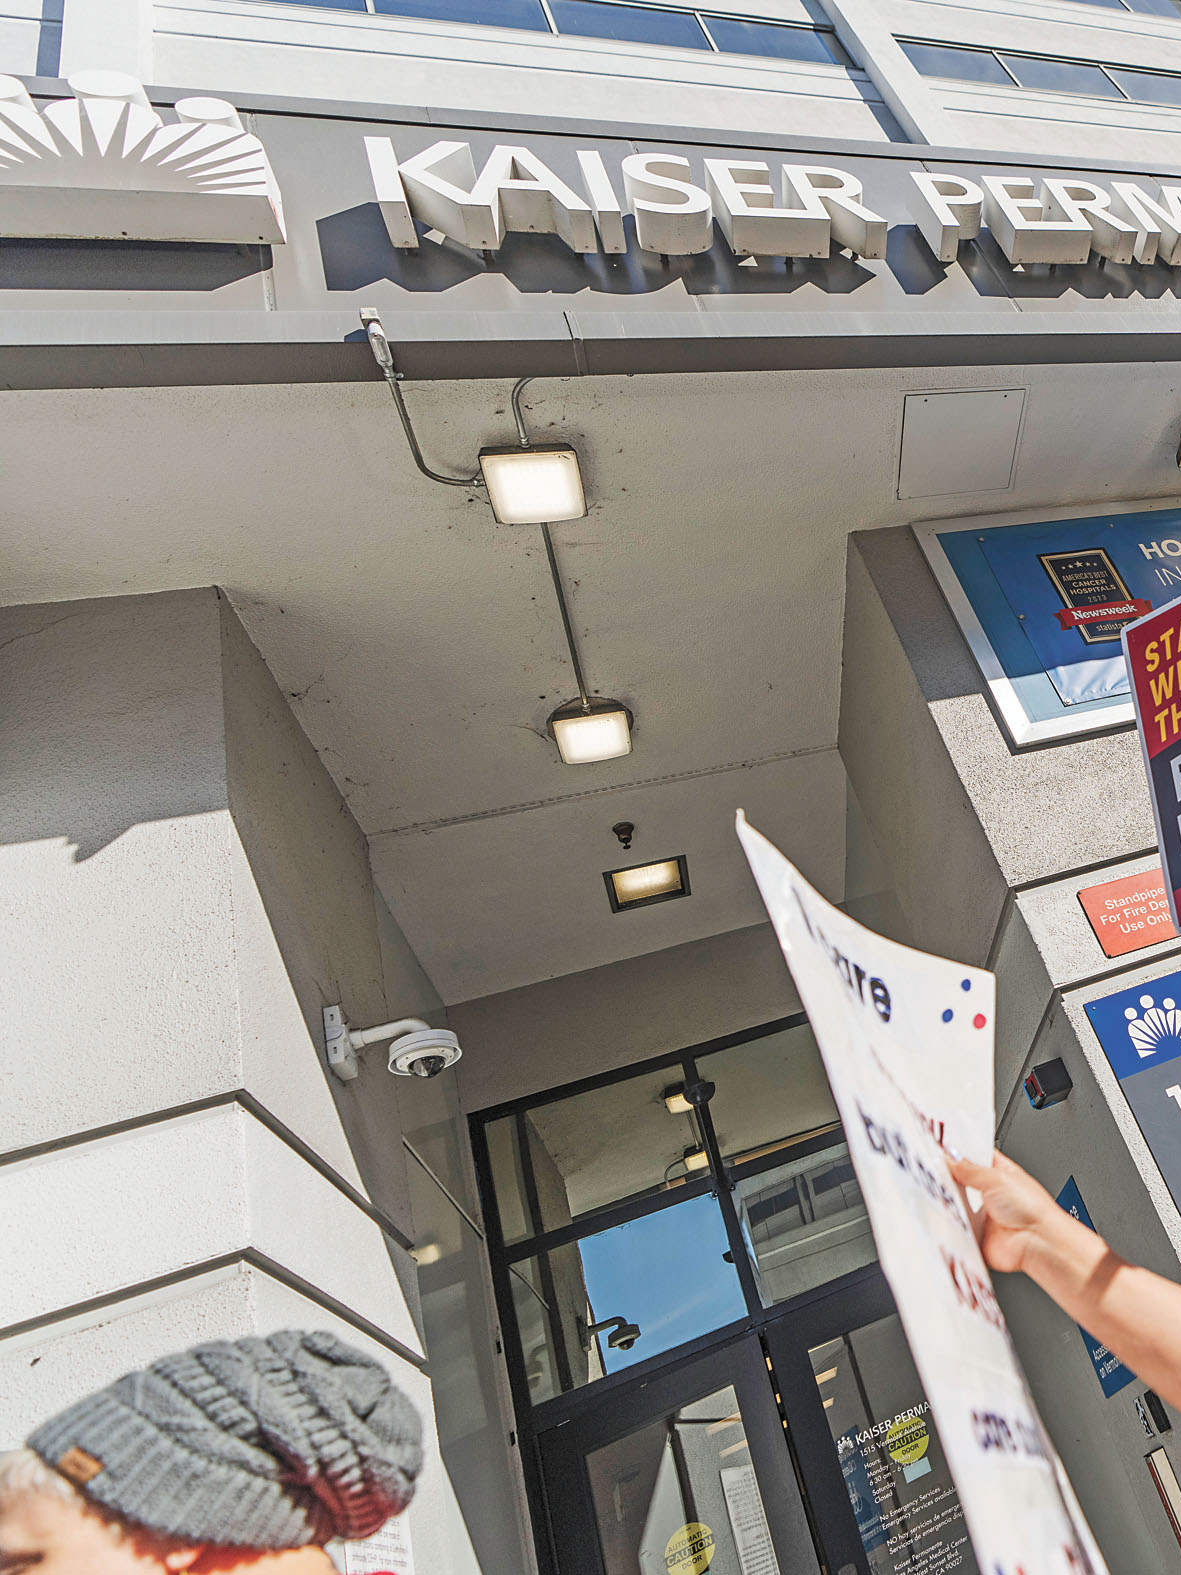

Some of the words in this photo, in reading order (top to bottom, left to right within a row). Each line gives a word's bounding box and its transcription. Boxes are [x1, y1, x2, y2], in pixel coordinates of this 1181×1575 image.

[363, 136, 888, 245] KAISER
[1069, 584, 1116, 595] HOSPITALS
[1072, 579, 1107, 588] CANCER
[1071, 603, 1138, 621] Newsweek
[1104, 887, 1165, 910] Standpipe
[1100, 913, 1121, 926] For
[1123, 906, 1148, 919] Fire
[1120, 921, 1145, 934] Use
[855, 1418, 893, 1445] KAISER
[888, 1427, 927, 1452] CAUTION
[859, 1440, 876, 1457] 1515
[901, 1443, 920, 1455] DOOR
[867, 1464, 889, 1479] Monday
[872, 1480, 896, 1497] Saturday
[874, 1490, 893, 1504] Closed
[879, 1514, 889, 1522] No
[889, 1498, 919, 1518] Emergency
[918, 1487, 941, 1502] Services
[882, 1512, 911, 1531] Emergency
[911, 1500, 934, 1515] Services
[667, 1528, 708, 1554] AUTOMATIC
[889, 1539, 914, 1555] Servicios
[666, 1535, 713, 1567] CAUTION
[894, 1559, 911, 1572] Kaiser
[911, 1541, 943, 1561] Permanente
[907, 1558, 929, 1575] Angeles
[929, 1544, 950, 1561] Medical
[950, 1536, 968, 1549] Center
[681, 1554, 703, 1570] DOOR
[929, 1557, 947, 1571] Sunset
[945, 1555, 963, 1571] 90027
